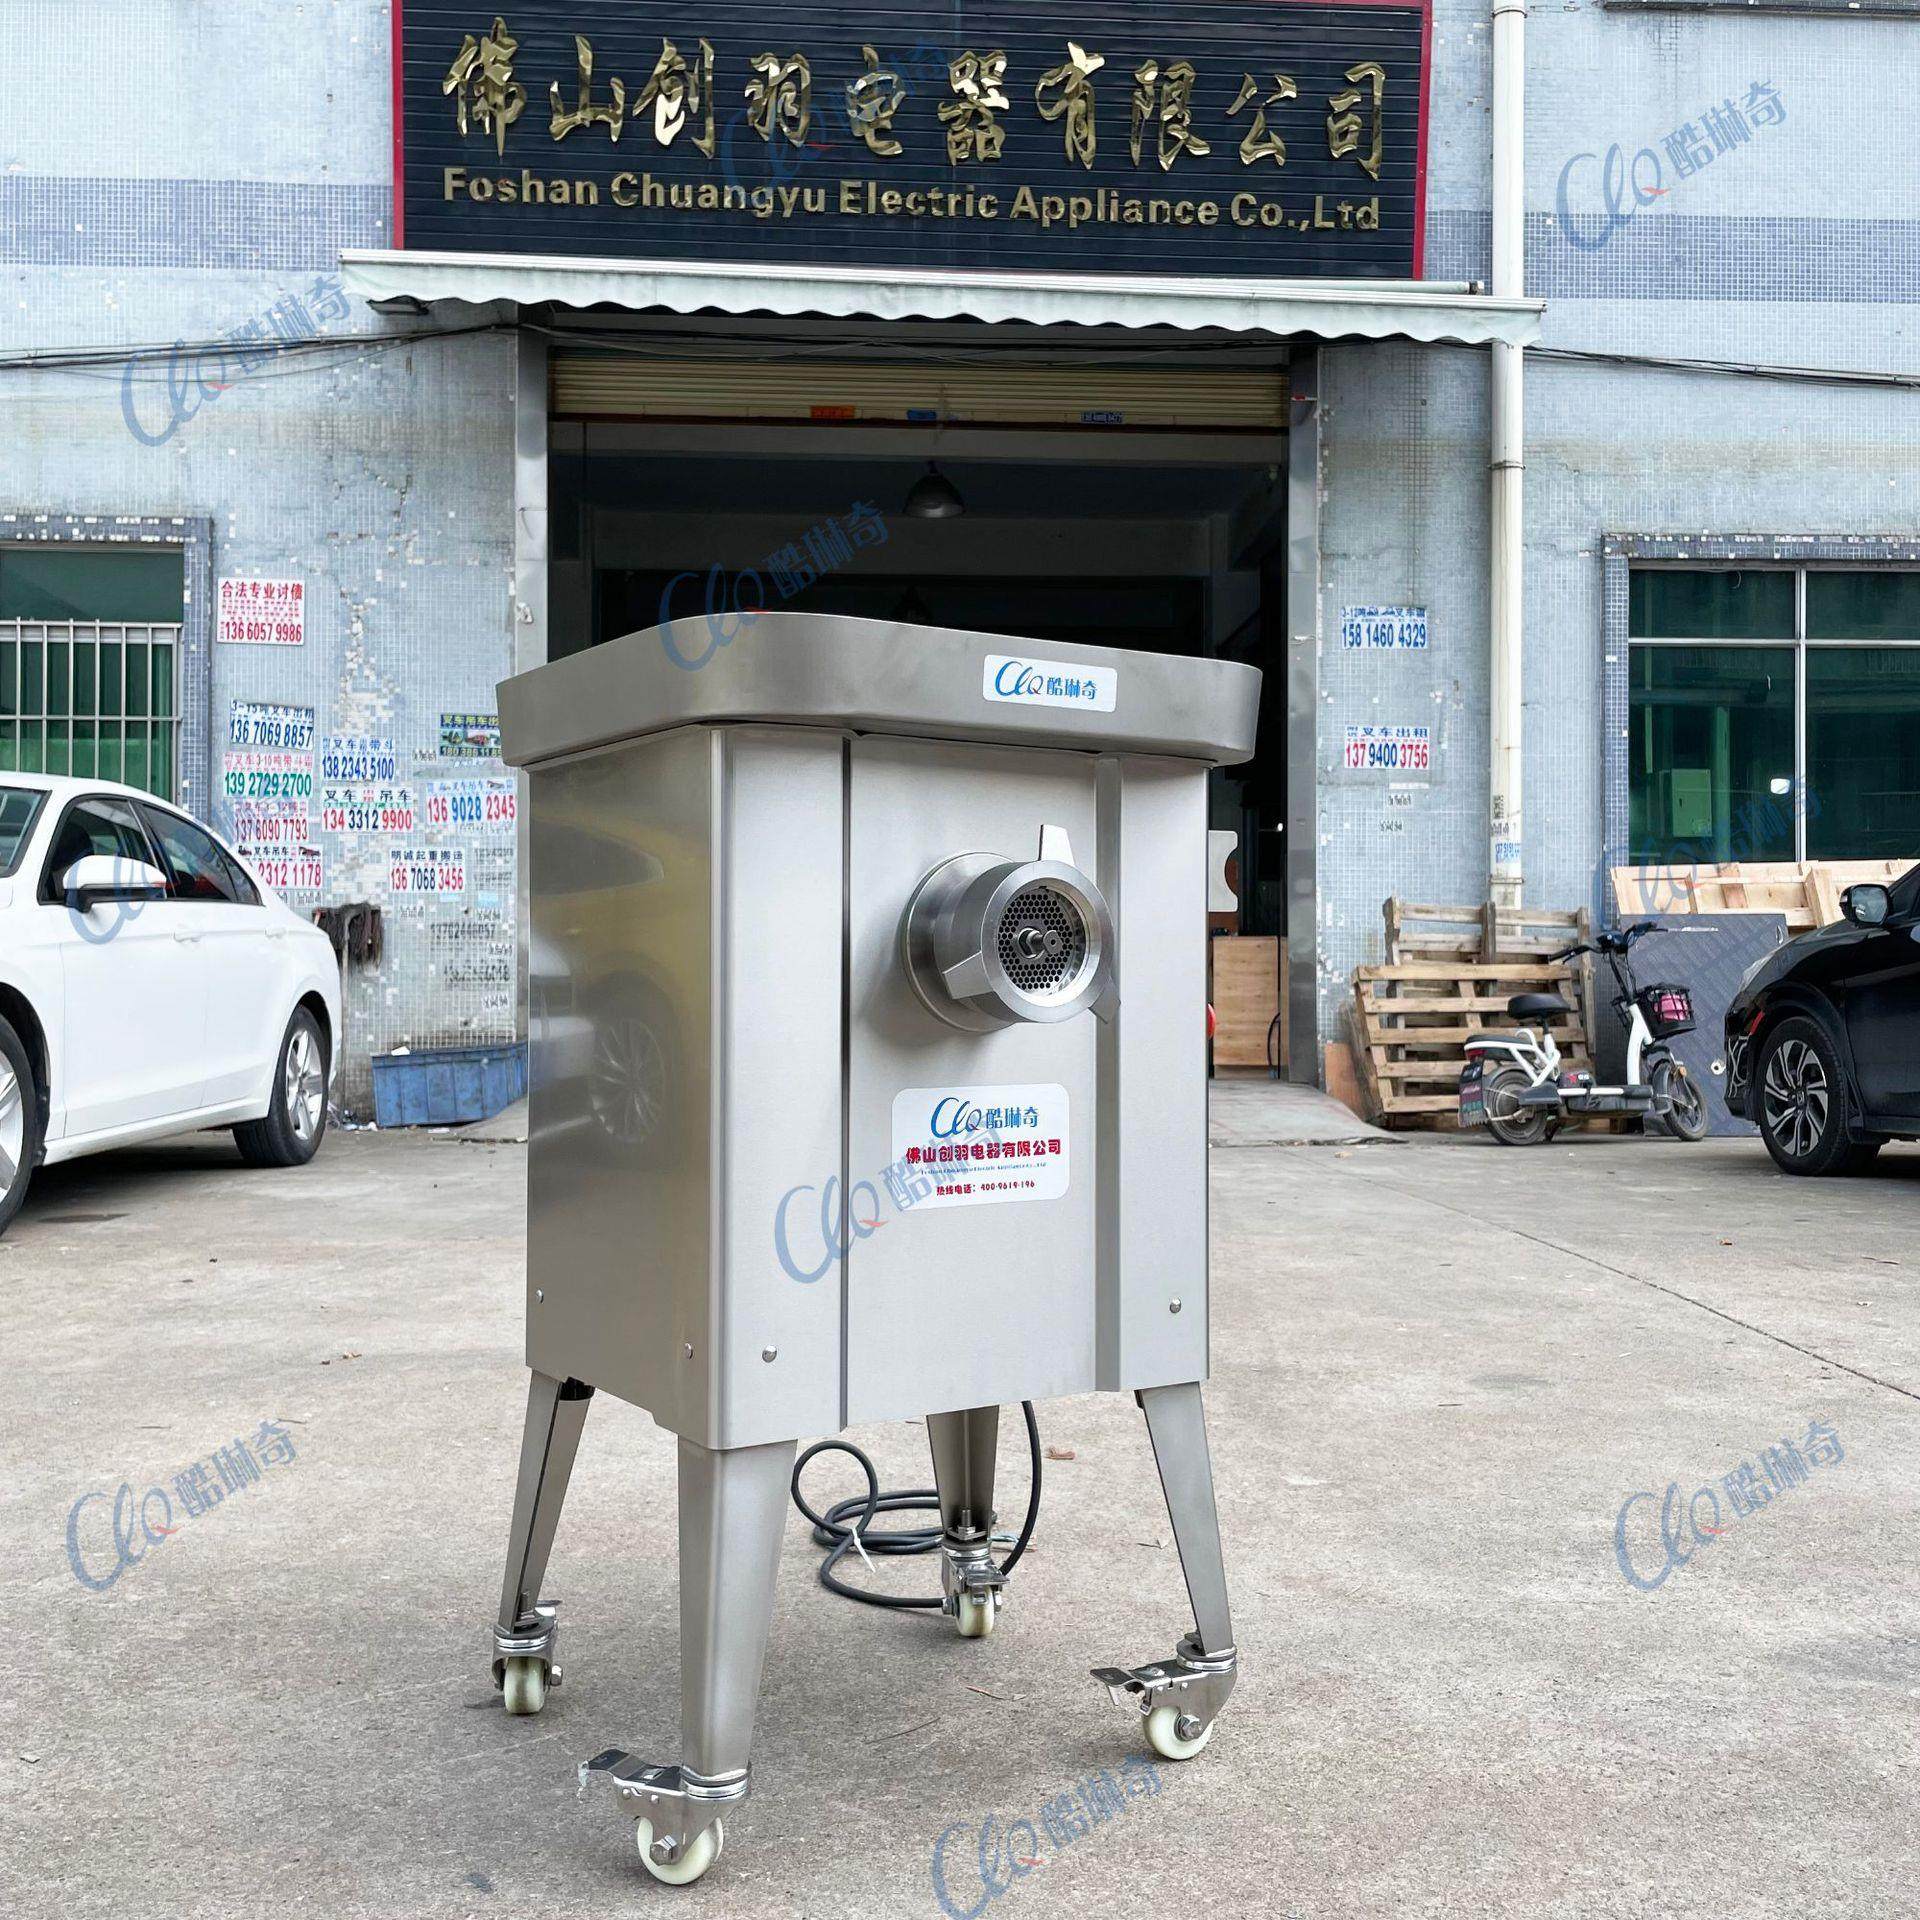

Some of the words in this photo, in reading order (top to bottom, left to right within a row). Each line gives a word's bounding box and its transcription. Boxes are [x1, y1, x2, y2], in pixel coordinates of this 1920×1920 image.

[442, 17, 1385, 181] 佛山创羽电器有限公司
[443, 167, 598, 206] Foshan
[610, 171, 826, 219] Chuangyu
[839, 180, 998, 218] Electric
[1010, 186, 1219, 229] Appliance
[1231, 192, 1380, 232] Co.,Ltd
[221, 580, 303, 600] 合法专业讨债
[225, 621, 244, 640] 136
[247, 622, 273, 640] 6057
[275, 623, 302, 642] 9986
[1343, 623, 1361, 647] 158
[1367, 623, 1394, 647] 1460
[1398, 623, 1426, 647] 4329
[1046, 675, 1097, 699] 酷琳奇
[230, 719, 249, 743] 136
[253, 721, 281, 746] 7069
[284, 723, 314, 747] 8857
[1361, 727, 1427, 738] 叉车出租
[1346, 743, 1366, 767] 137
[1369, 743, 1397, 767] 9400
[1400, 743, 1428, 768] 3756
[322, 755, 339, 778] 138
[341, 756, 367, 780] 2343
[370, 757, 394, 781] 5100
[225, 772, 245, 796] 139
[248, 772, 279, 797] 2729
[282, 773, 311, 797] 2700
[323, 808, 345, 830] 134
[348, 809, 379, 829] 3312
[382, 809, 412, 830] 9900
[428, 795, 448, 822] 136
[452, 796, 482, 822] 9028
[486, 795, 515, 820] 2345
[236, 818, 252, 841] 137
[255, 818, 280, 841] 6090
[283, 818, 308, 840] 7793
[293, 863, 321, 886] 1178
[391, 868, 408, 890] 136
[411, 868, 436, 890] 7068
[438, 868, 464, 890] 3456
[986, 1106, 1039, 1129] 酷琳奇
[905, 1138, 1062, 1165] 佛山创羽电器有限公司
